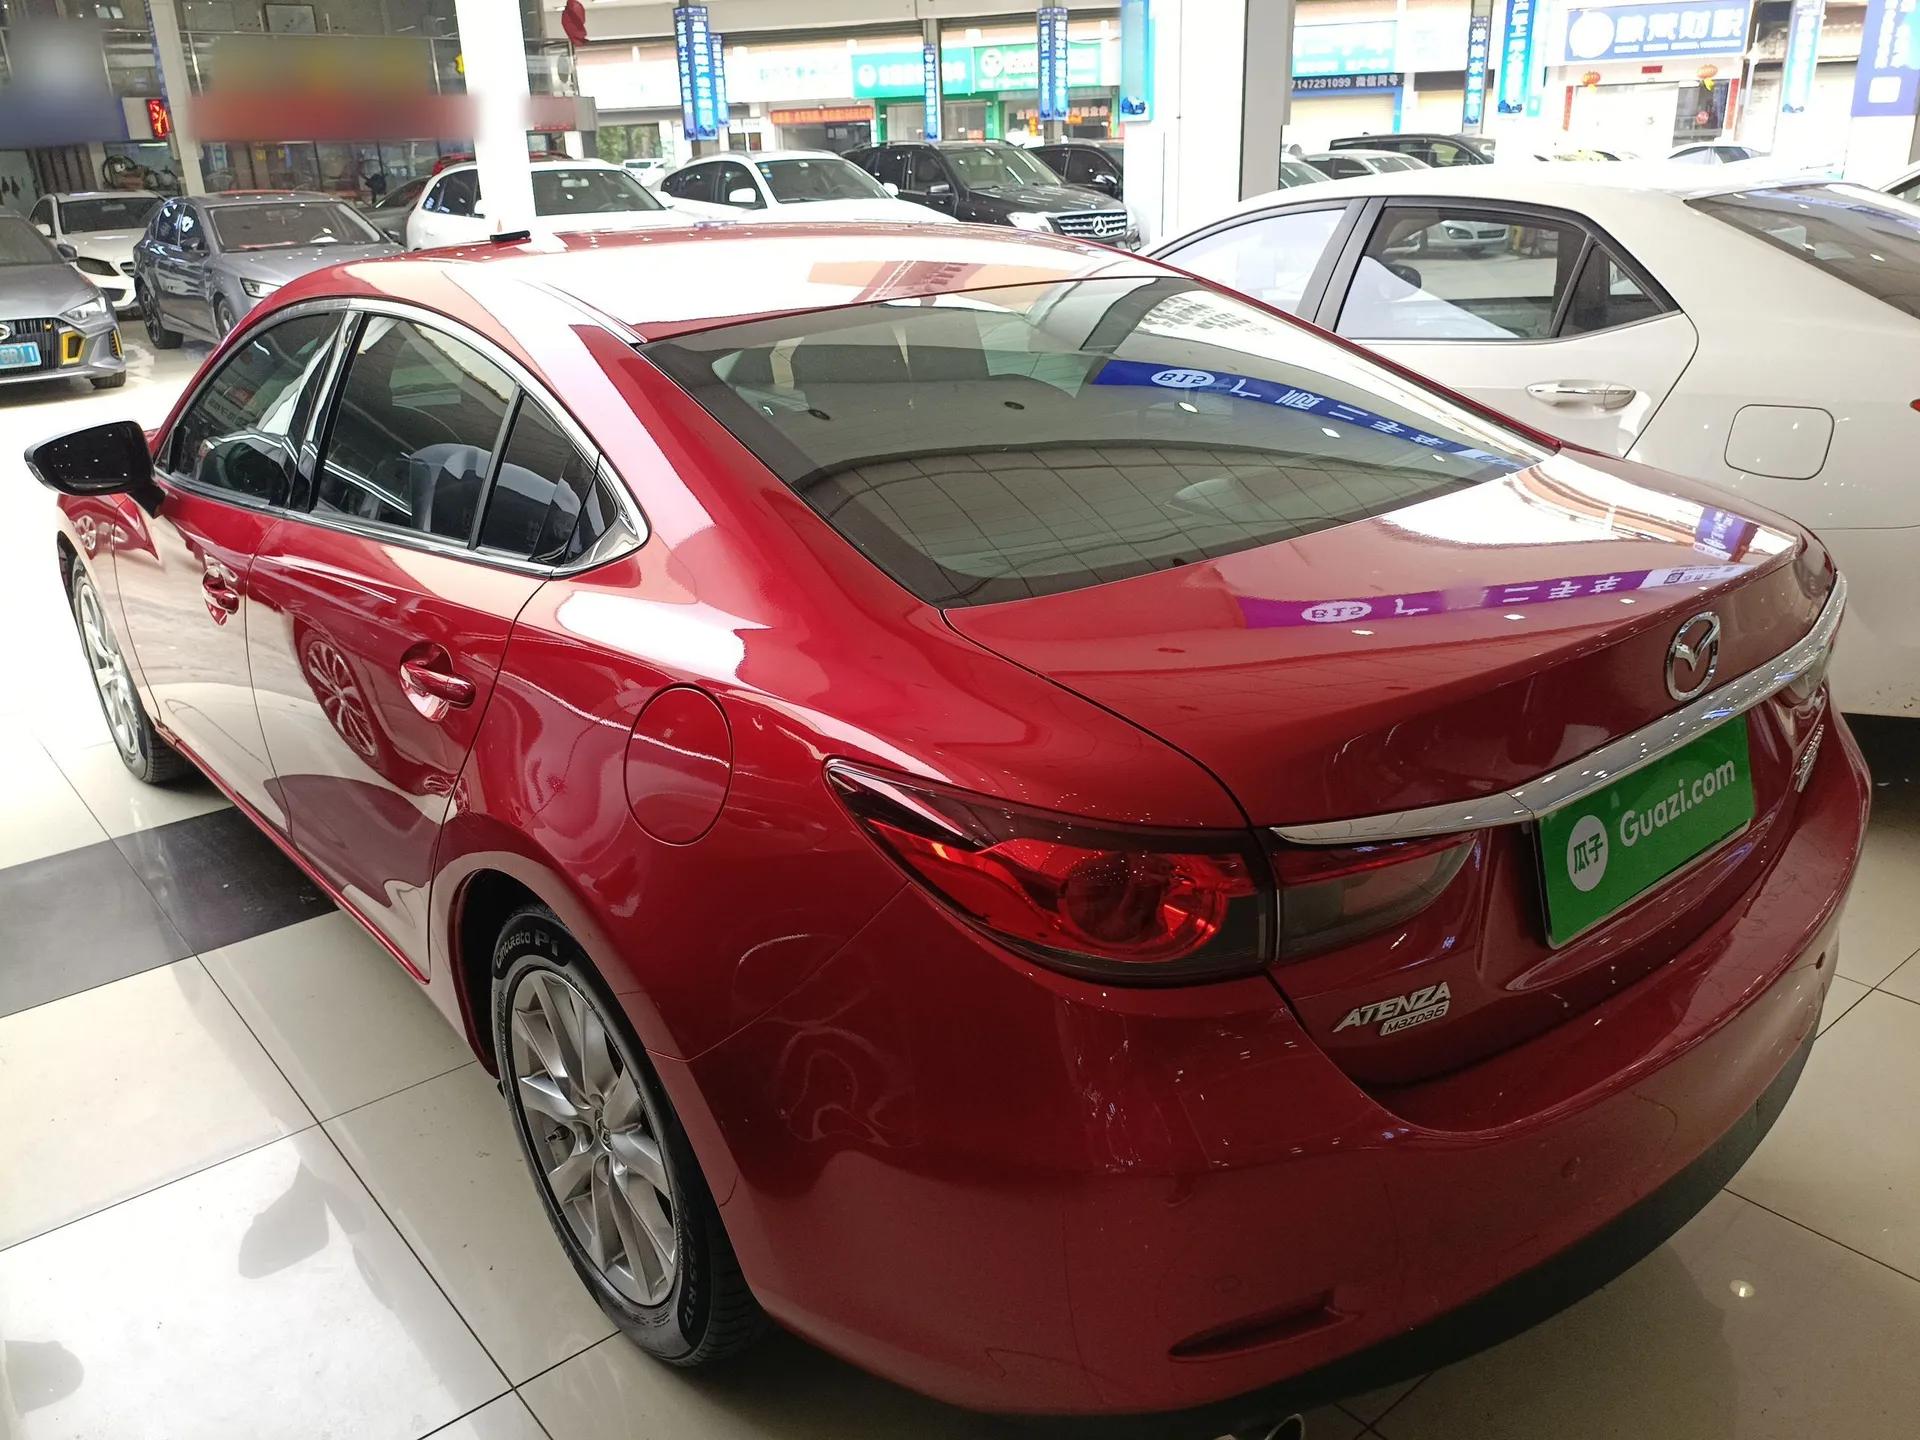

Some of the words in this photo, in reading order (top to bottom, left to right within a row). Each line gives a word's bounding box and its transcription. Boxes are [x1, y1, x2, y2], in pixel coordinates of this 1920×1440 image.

[1620, 760, 1736, 847] Guazi.com
[1573, 832, 1604, 875] 瓜子
[1332, 981, 1452, 1033] ATENZA
